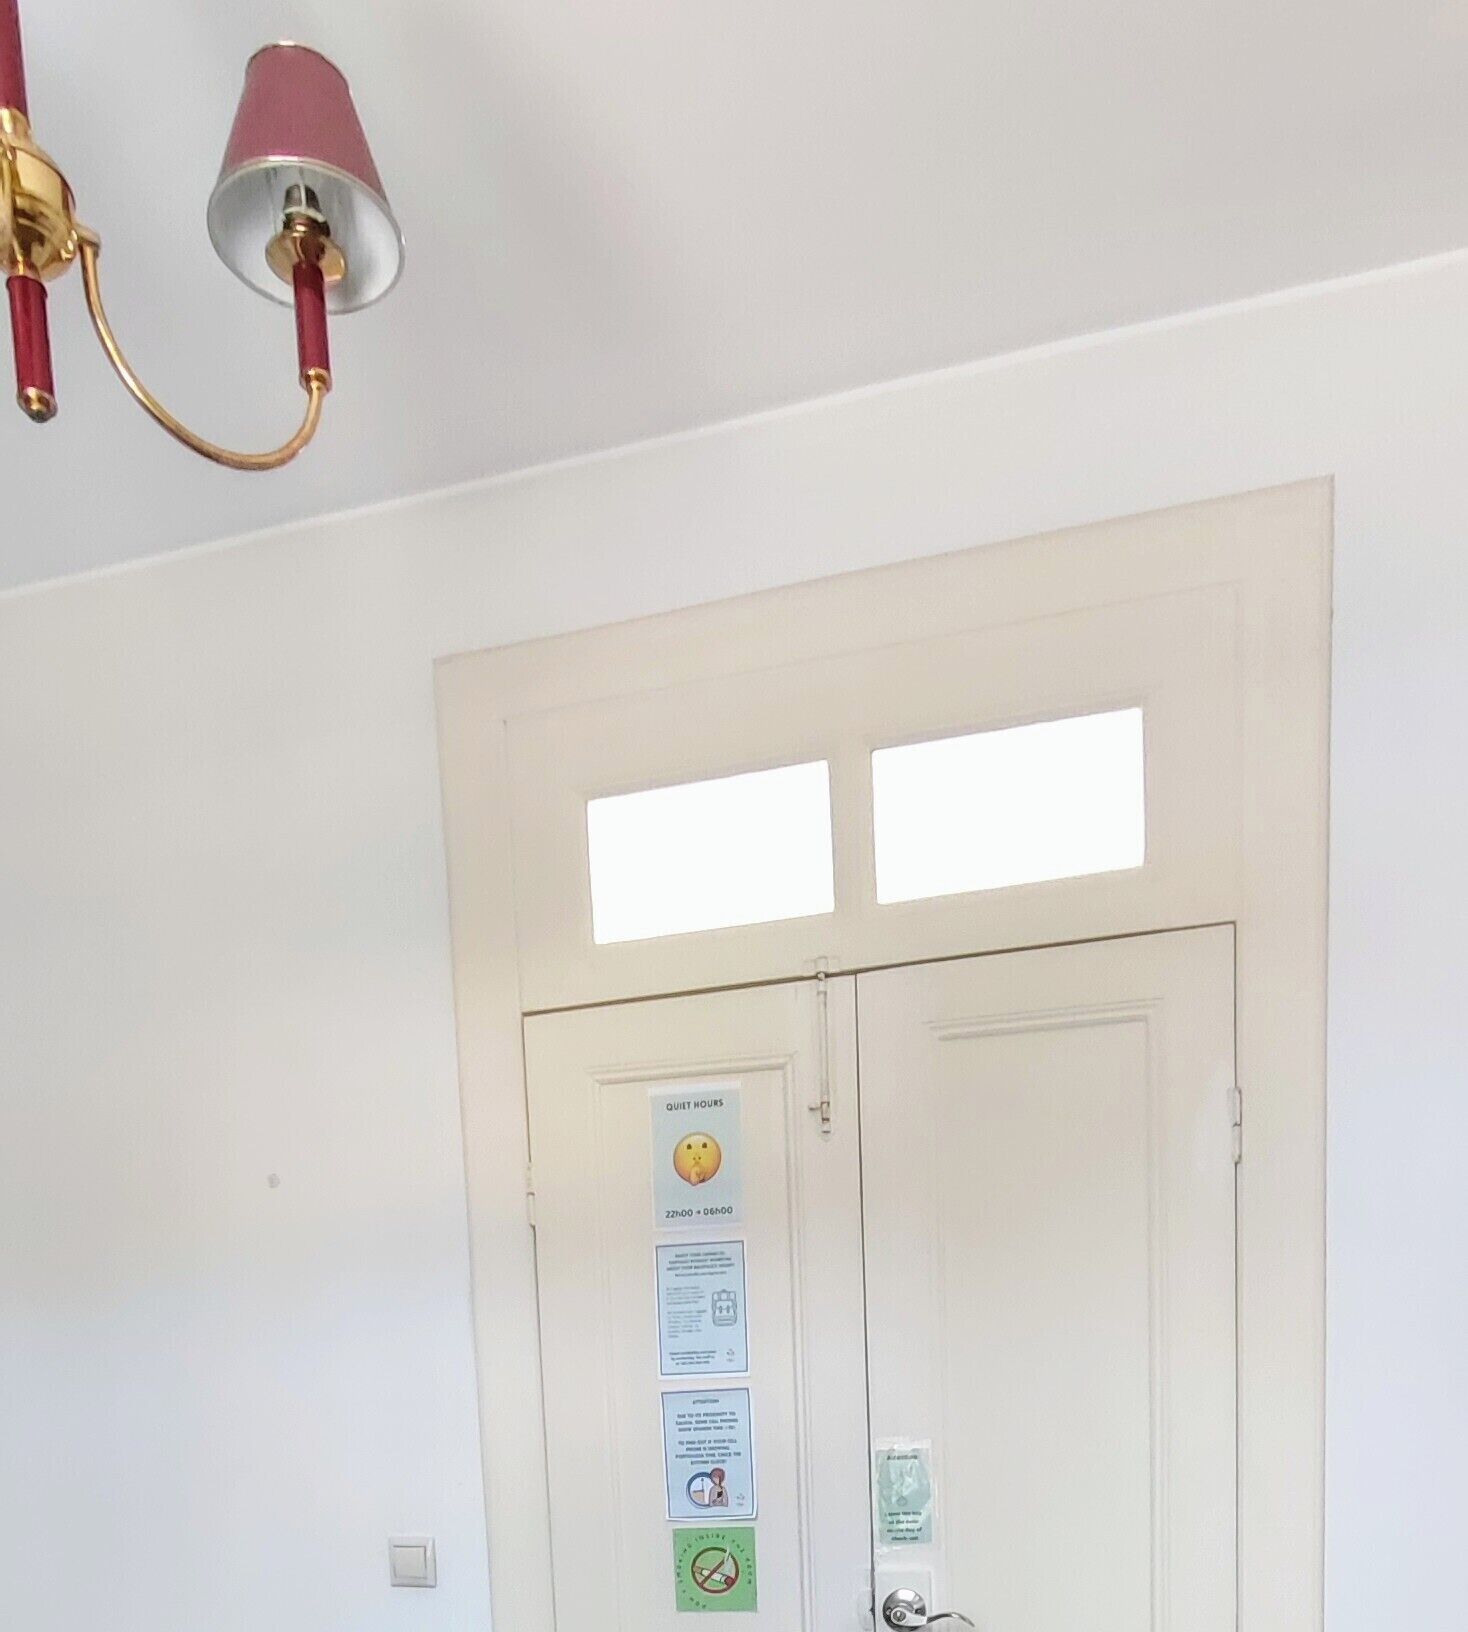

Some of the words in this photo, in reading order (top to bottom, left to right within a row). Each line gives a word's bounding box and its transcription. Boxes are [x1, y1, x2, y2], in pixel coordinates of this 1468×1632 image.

[666, 1101, 691, 1111] QUIET
[693, 1099, 724, 1109] HOURS
[665, 1209, 693, 1219] 22h00
[703, 1206, 733, 1216] 06h00
